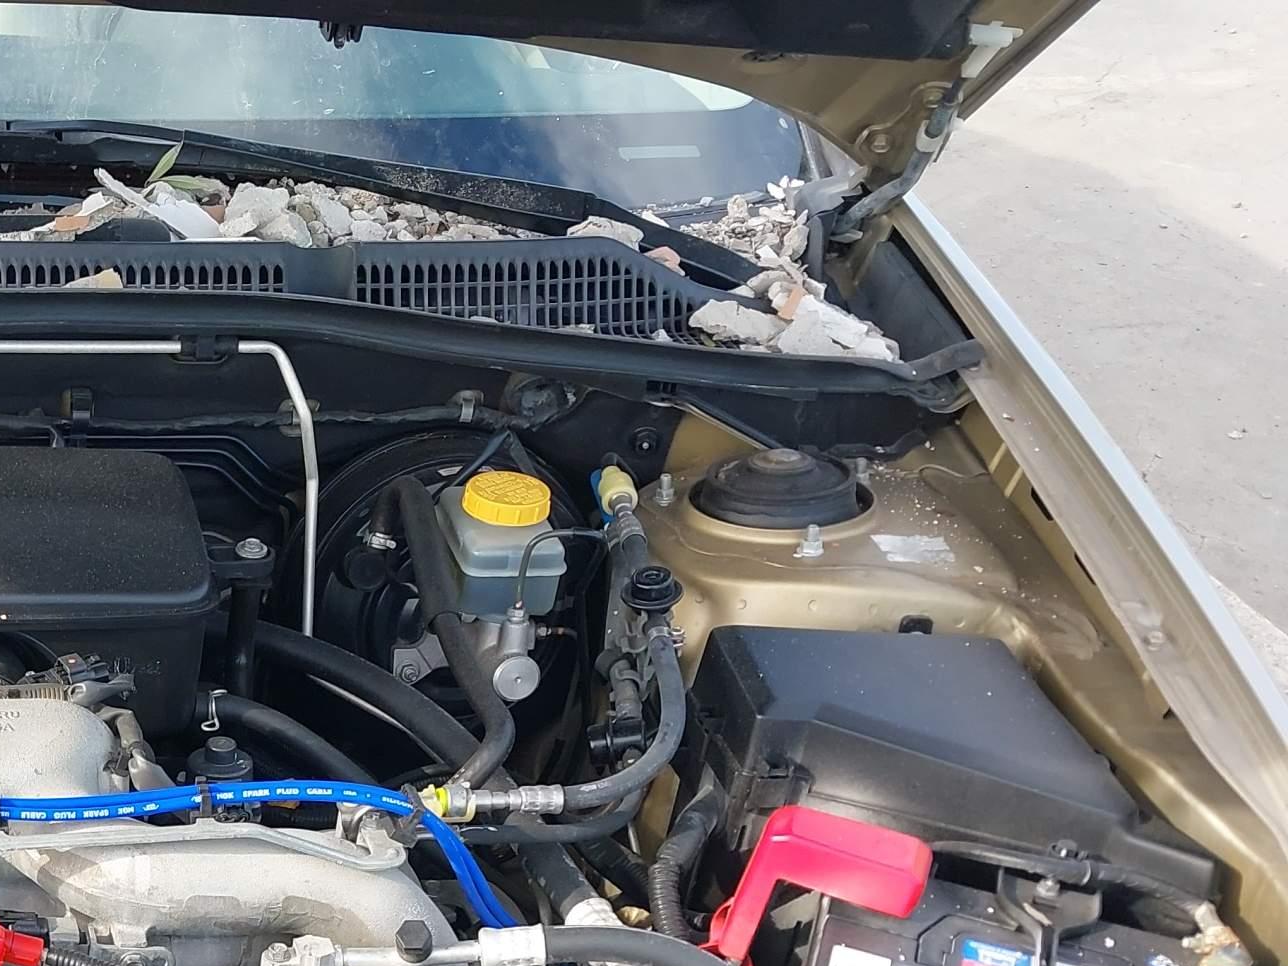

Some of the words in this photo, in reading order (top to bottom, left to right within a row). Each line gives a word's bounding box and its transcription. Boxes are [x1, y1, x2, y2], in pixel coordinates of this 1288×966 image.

[242, 788, 270, 799] SPARK
[306, 787, 333, 797] CABLE
[20, 810, 47, 820] CABLE
[53, 810, 77, 820] PLUG
[83, 808, 109, 818] SPARK
